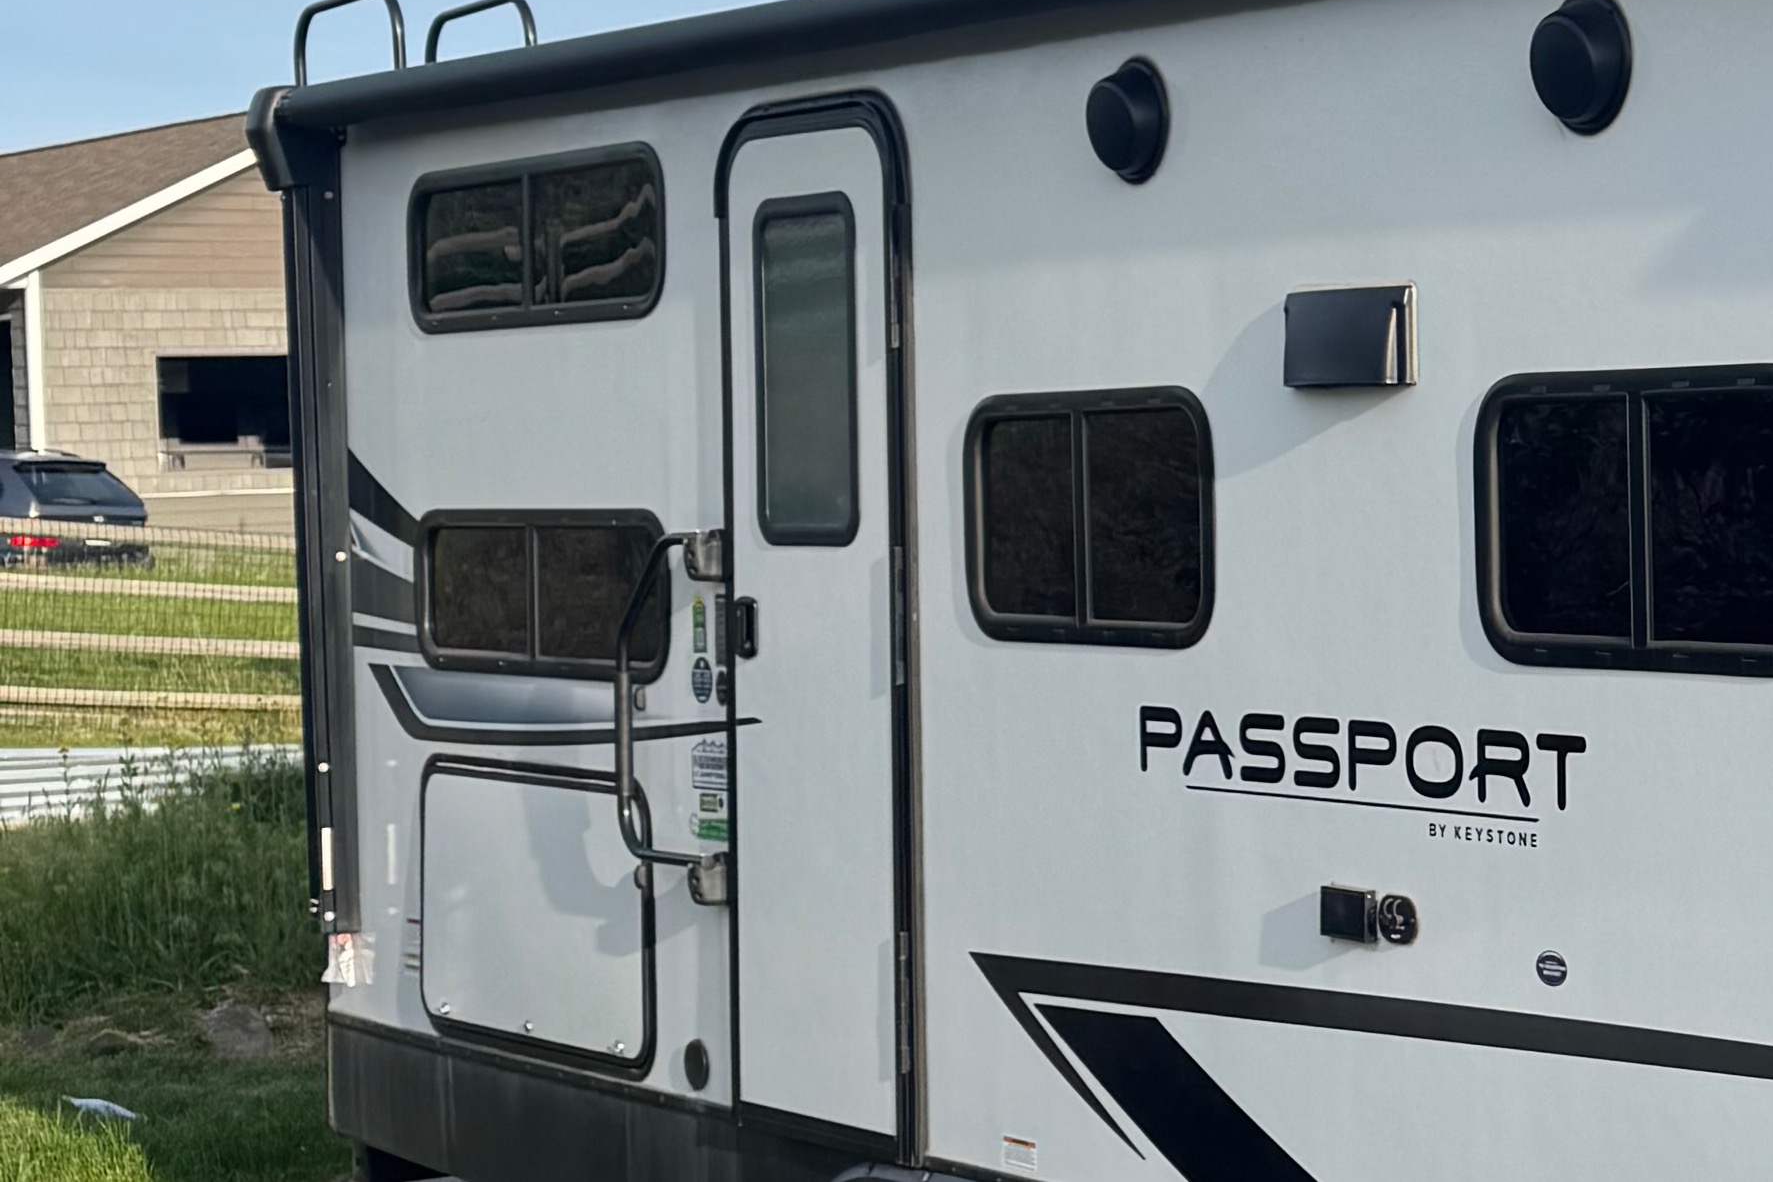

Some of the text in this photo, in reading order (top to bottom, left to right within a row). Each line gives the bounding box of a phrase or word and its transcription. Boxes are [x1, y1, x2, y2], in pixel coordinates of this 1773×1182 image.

[1139, 705, 1587, 811] PASSPORT
[1429, 822, 1538, 848] BY KEYSTONE
